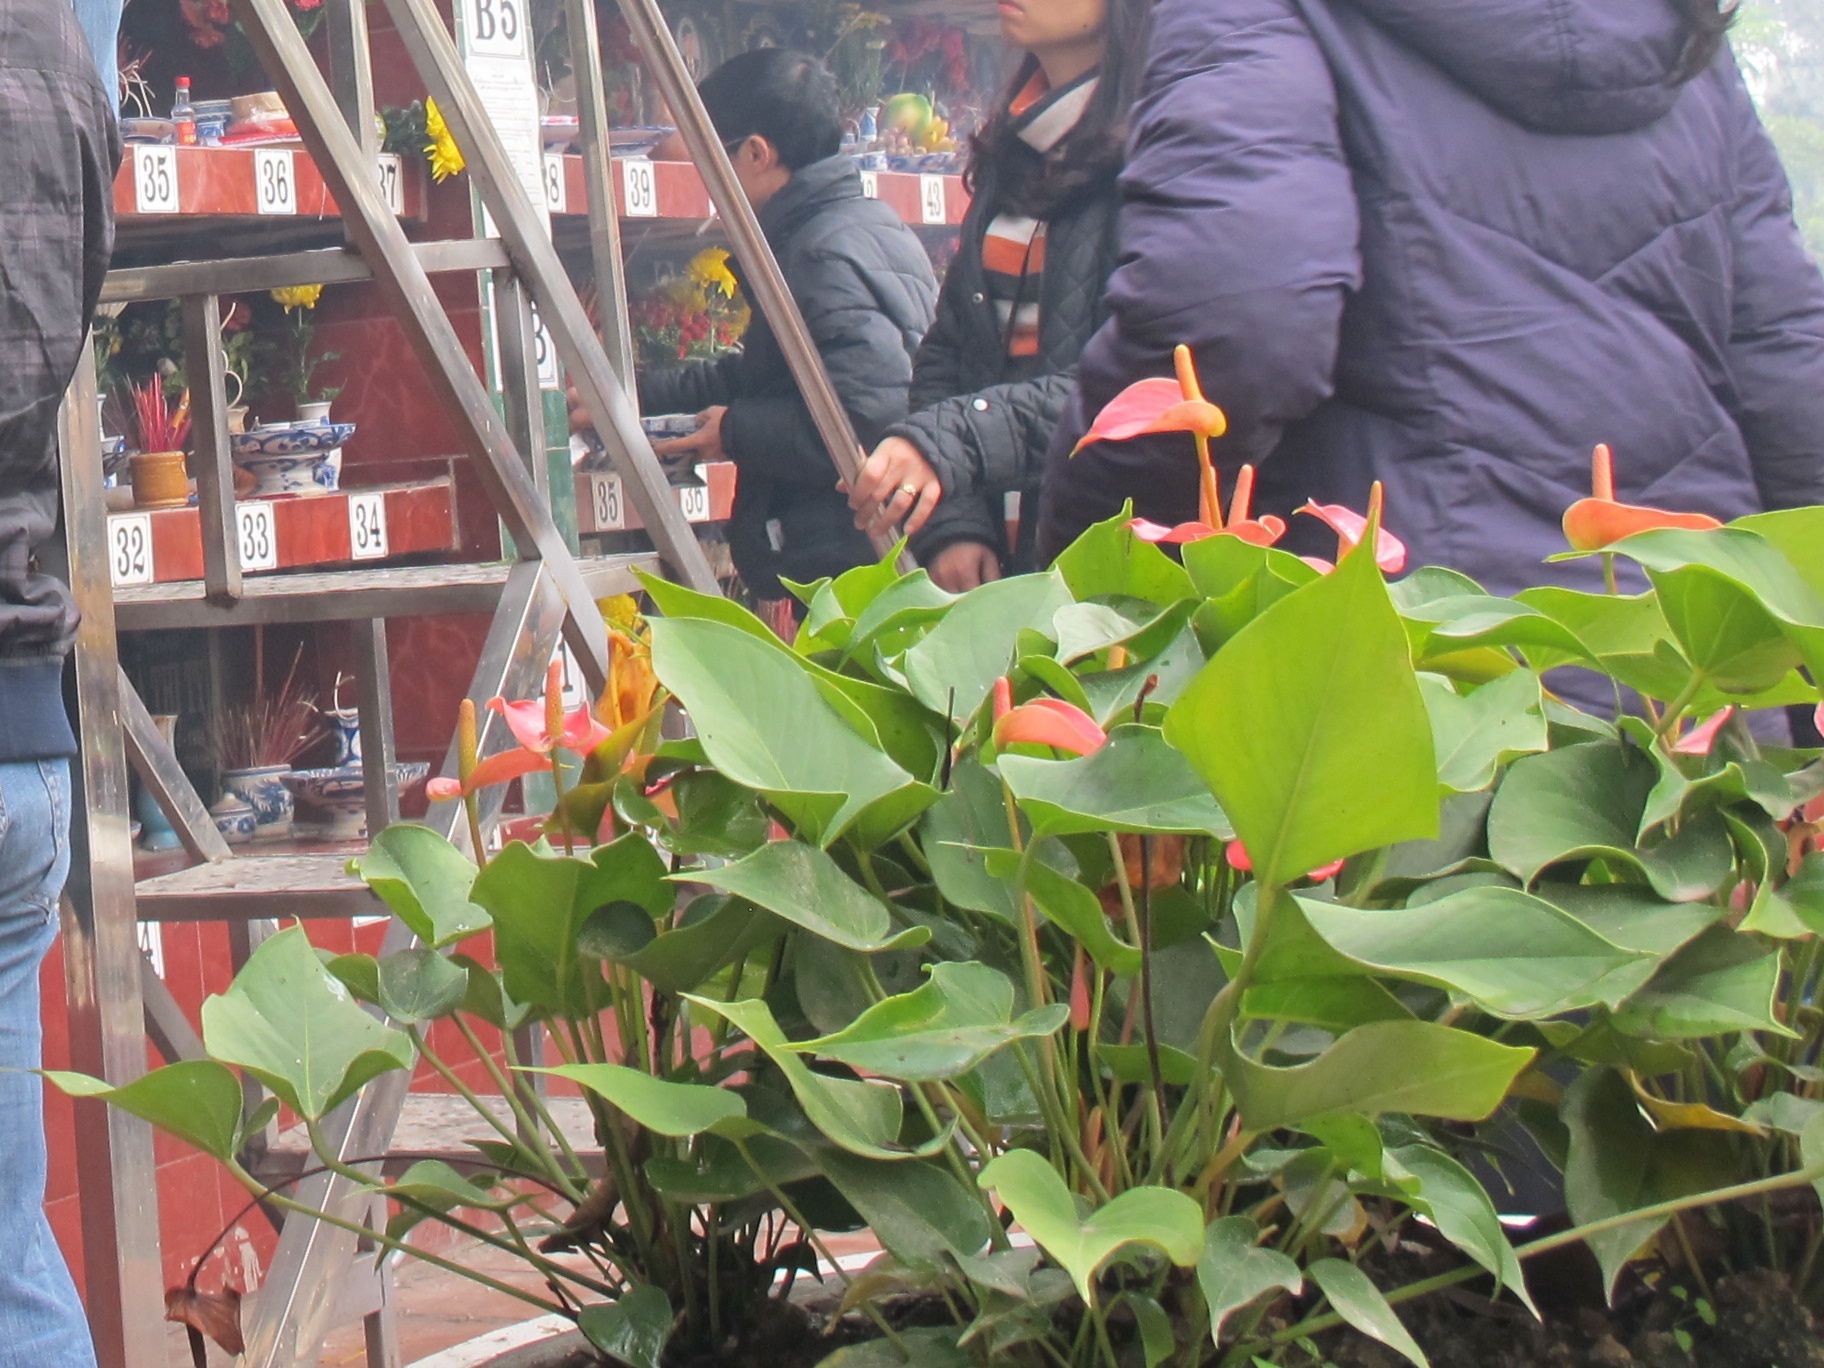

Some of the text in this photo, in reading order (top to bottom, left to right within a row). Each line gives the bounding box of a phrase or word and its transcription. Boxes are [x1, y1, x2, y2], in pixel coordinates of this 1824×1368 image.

[144, 155, 169, 203] 35
[262, 160, 288, 204] 36
[545, 163, 560, 204] 8
[630, 167, 650, 208] 39
[927, 181, 942, 217] 43
[597, 481, 617, 522] 35
[243, 512, 268, 560] 33
[356, 503, 381, 548] 34
[117, 526, 145, 576] 32
